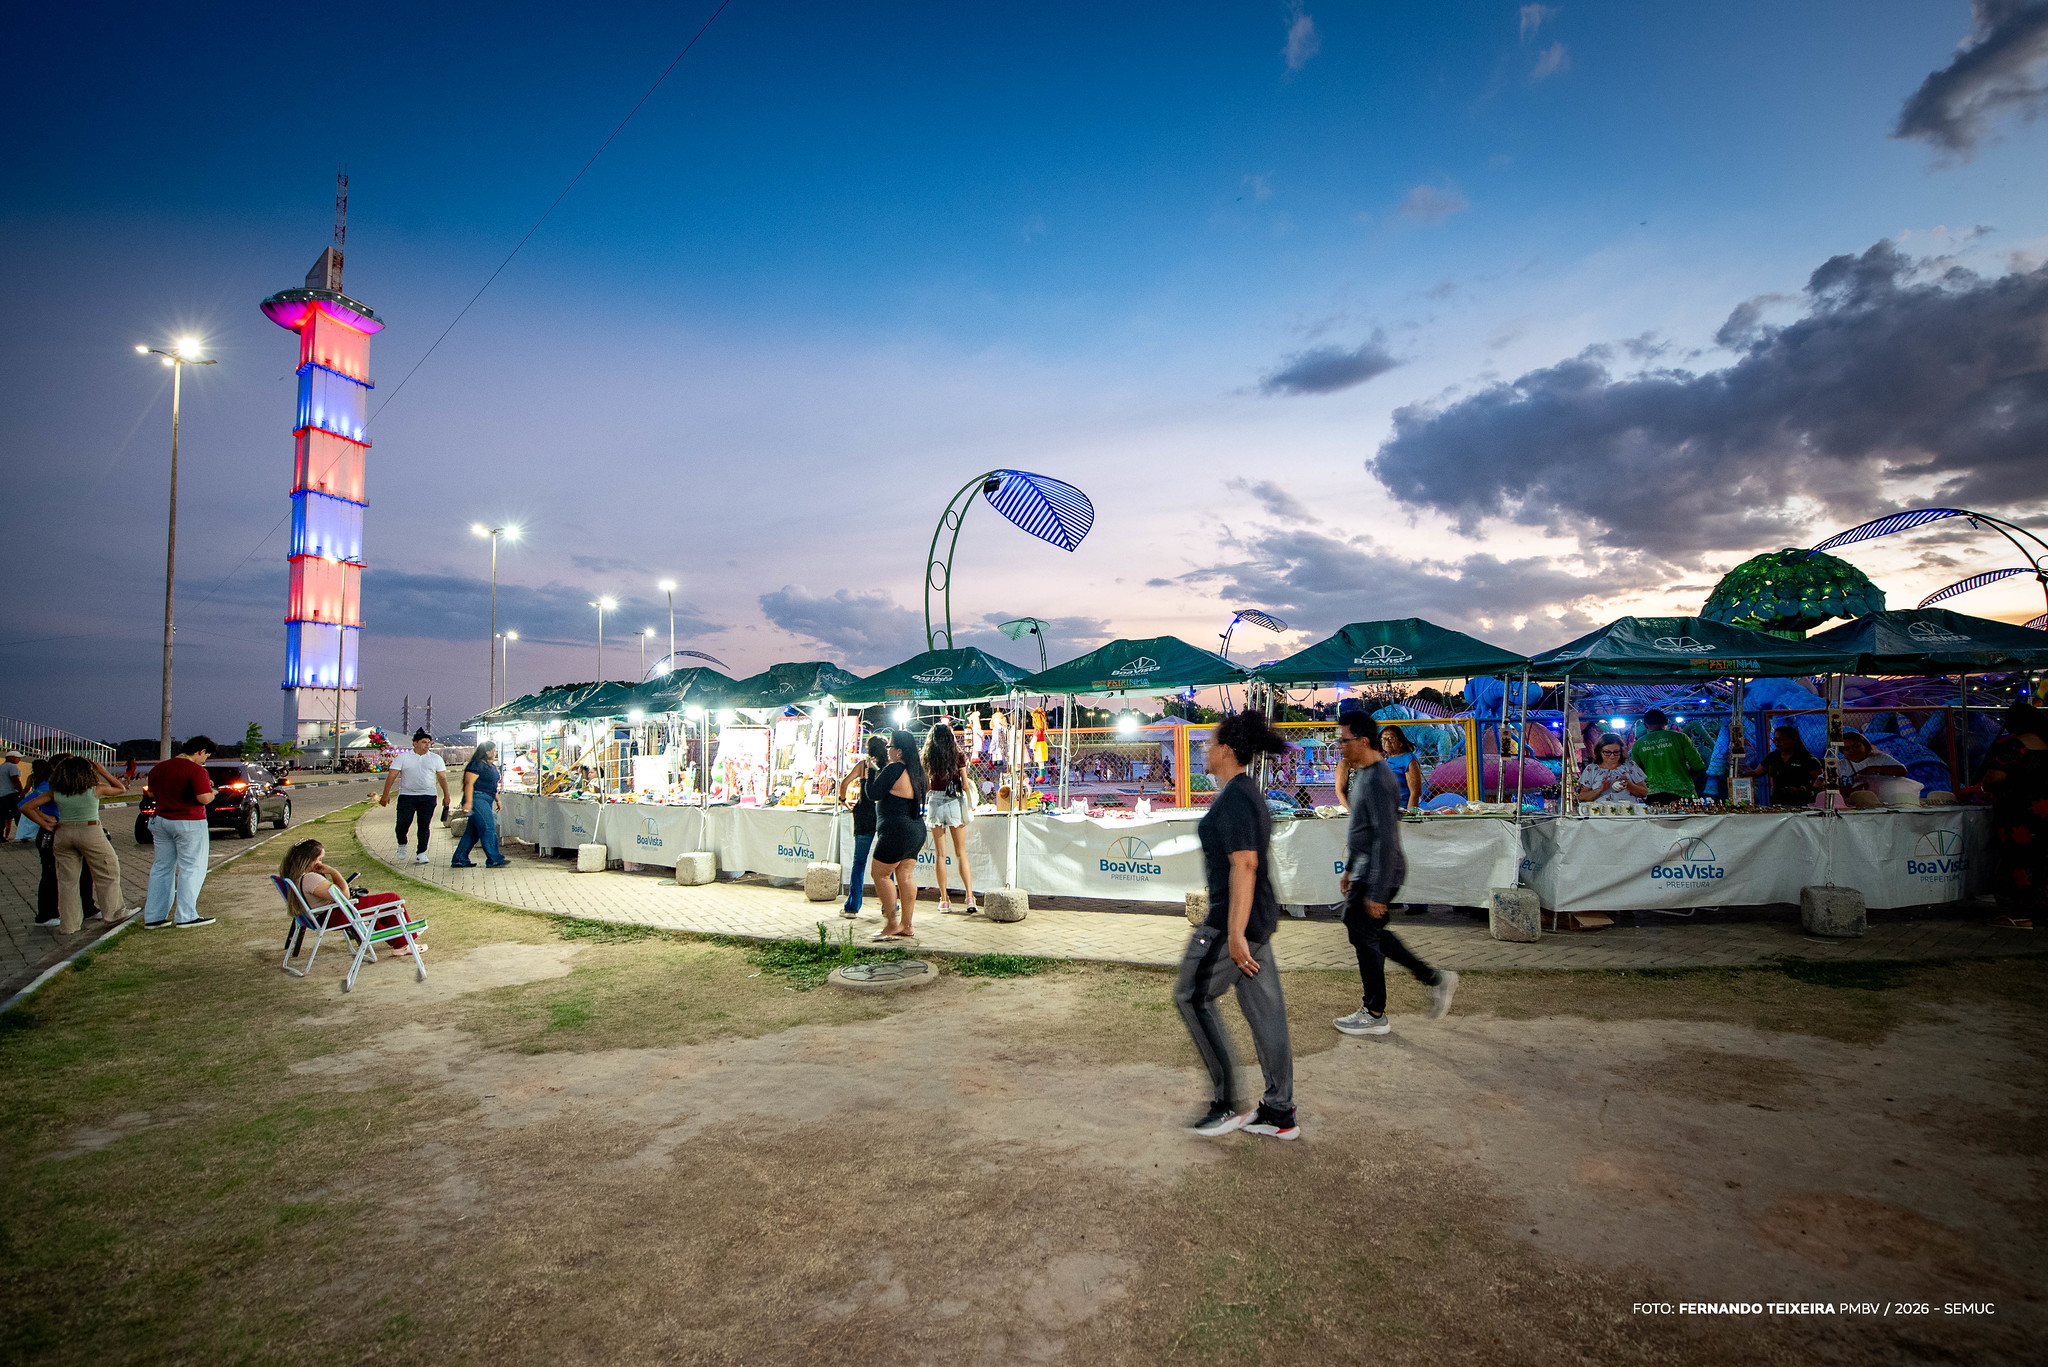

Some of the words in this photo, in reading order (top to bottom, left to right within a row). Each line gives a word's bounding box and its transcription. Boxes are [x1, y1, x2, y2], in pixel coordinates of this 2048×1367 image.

[777, 844, 815, 859] BoaVista
[1100, 859, 1162, 875] BoaVista
[1651, 864, 1725, 879] BoaVista
[1907, 859, 1970, 875] BoaVista
[1111, 874, 1150, 882] PREFEITURA
